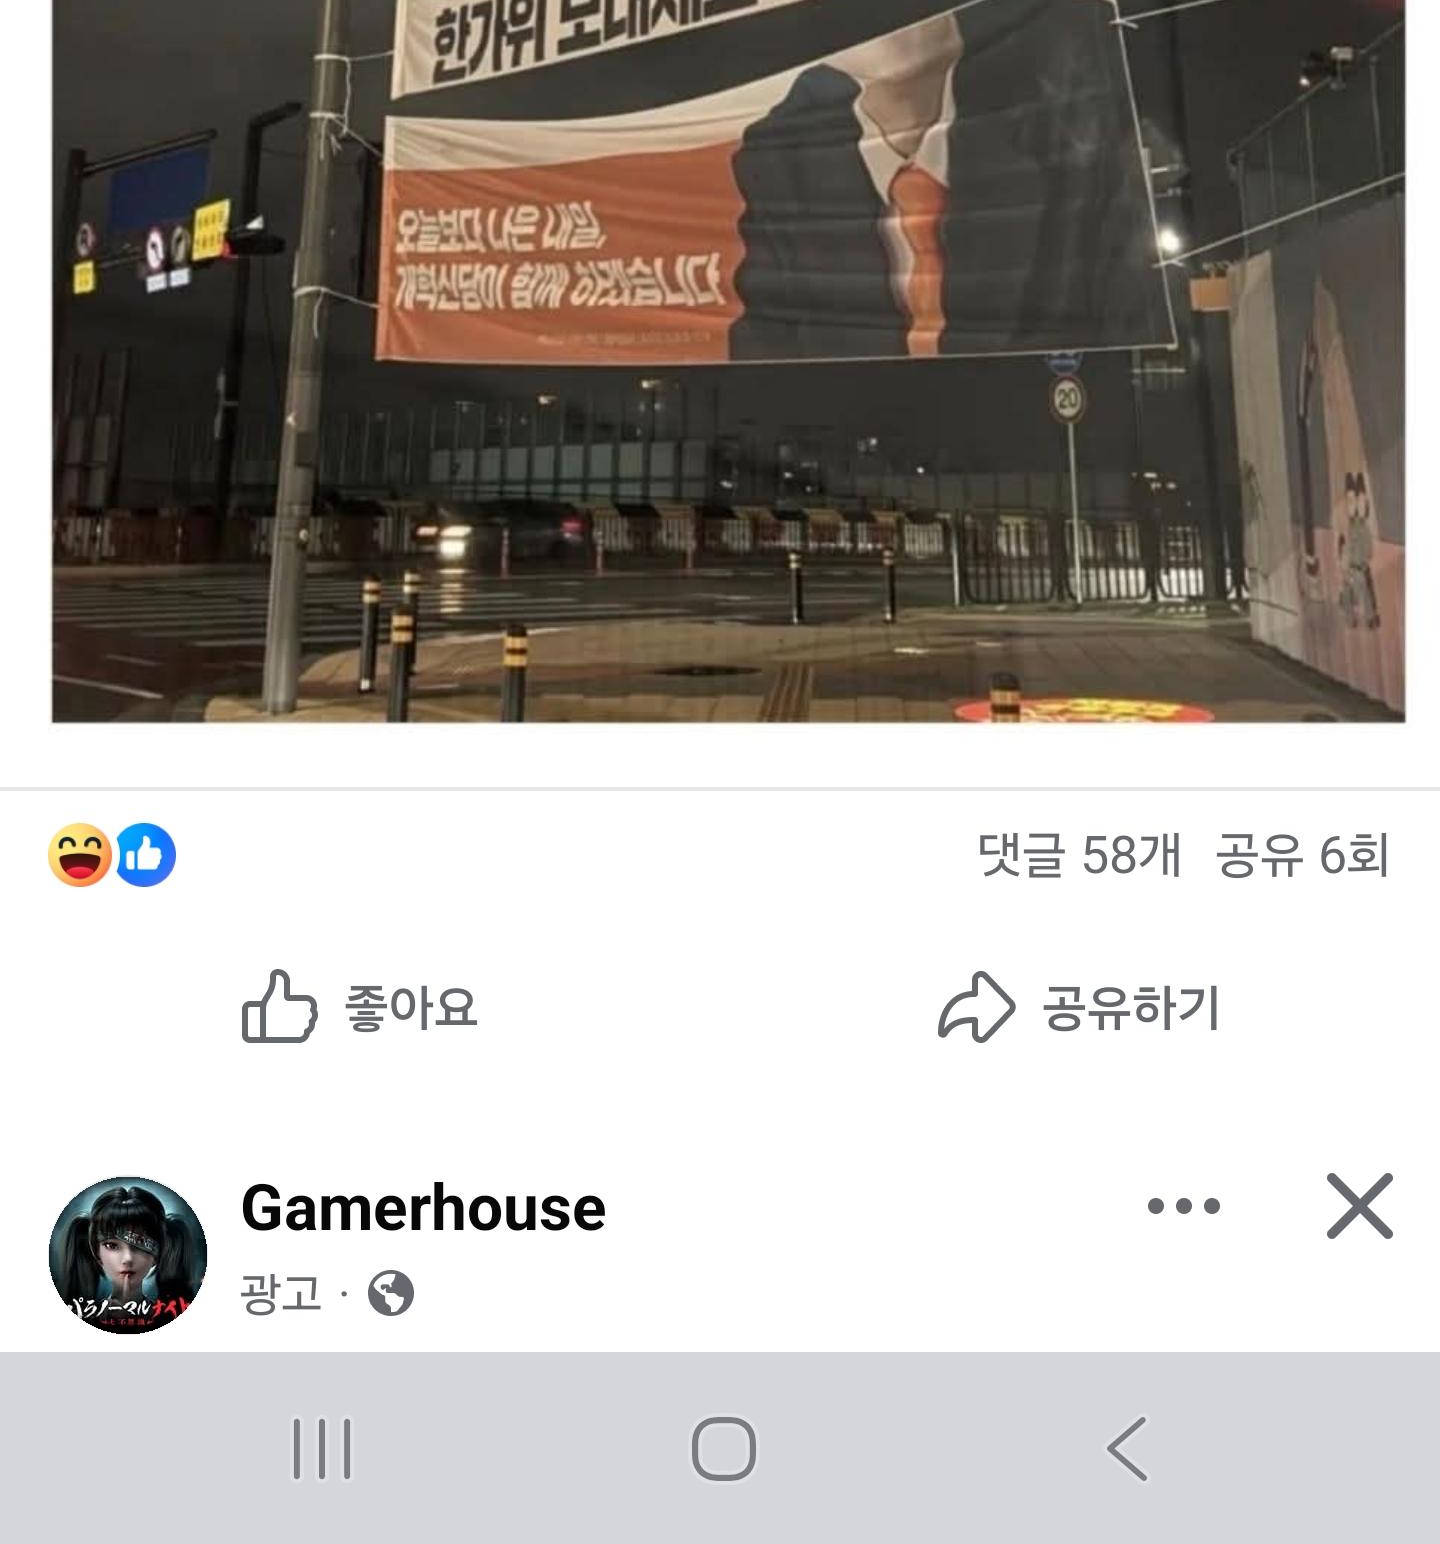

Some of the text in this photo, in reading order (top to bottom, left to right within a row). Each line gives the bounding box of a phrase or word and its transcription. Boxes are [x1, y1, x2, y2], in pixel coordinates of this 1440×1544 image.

[396, 200, 607, 253] 오늘보다 나은 내일,
[396, 252, 726, 311] 개혁신당이 함께 하겠습니다
[1058, 388, 1078, 409] 20
[980, 833, 1386, 878] 댓글 58개 공유 6회
[346, 986, 477, 1032] 좋아요
[1044, 986, 1217, 1031] 공유하기
[243, 1182, 605, 1231] Gamerhouse
[241, 1274, 321, 1315] 광고
